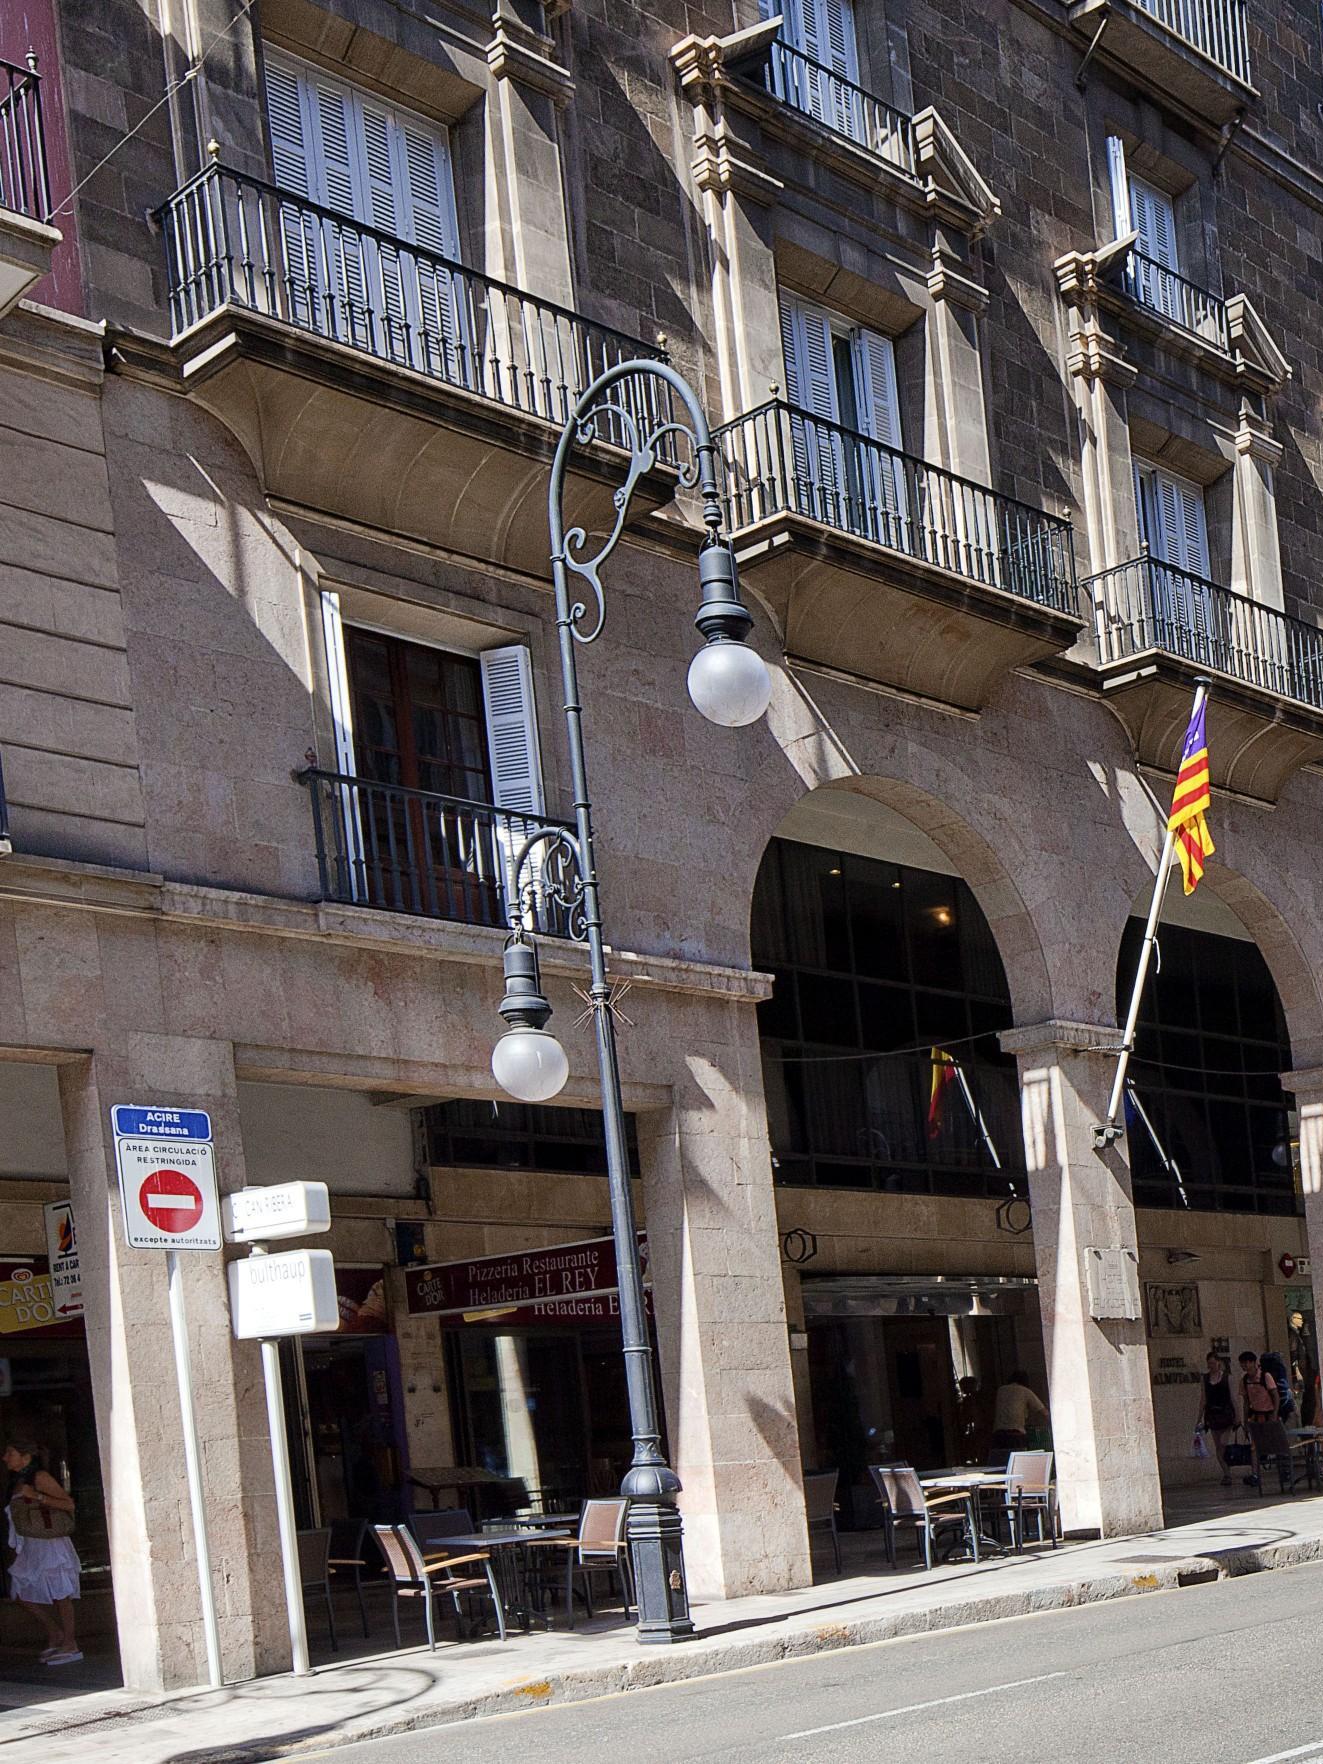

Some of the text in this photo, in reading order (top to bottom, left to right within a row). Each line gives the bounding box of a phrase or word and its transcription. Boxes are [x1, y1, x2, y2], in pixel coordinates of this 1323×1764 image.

[146, 1111, 181, 1123] ACIRE
[139, 1123, 189, 1135] Drassana
[125, 1143, 208, 1156] ÀREA CIRCULACIÓ
[136, 1156, 198, 1167] RESTRINGIDA
[133, 1235, 217, 1246] excepte autoritzats
[249, 1258, 306, 1287] bulthaup
[468, 1250, 599, 1283] Pizzeria Restaurante
[416, 1277, 443, 1296] CARTE
[534, 1273, 556, 1298] EL
[562, 1266, 600, 1293] REY
